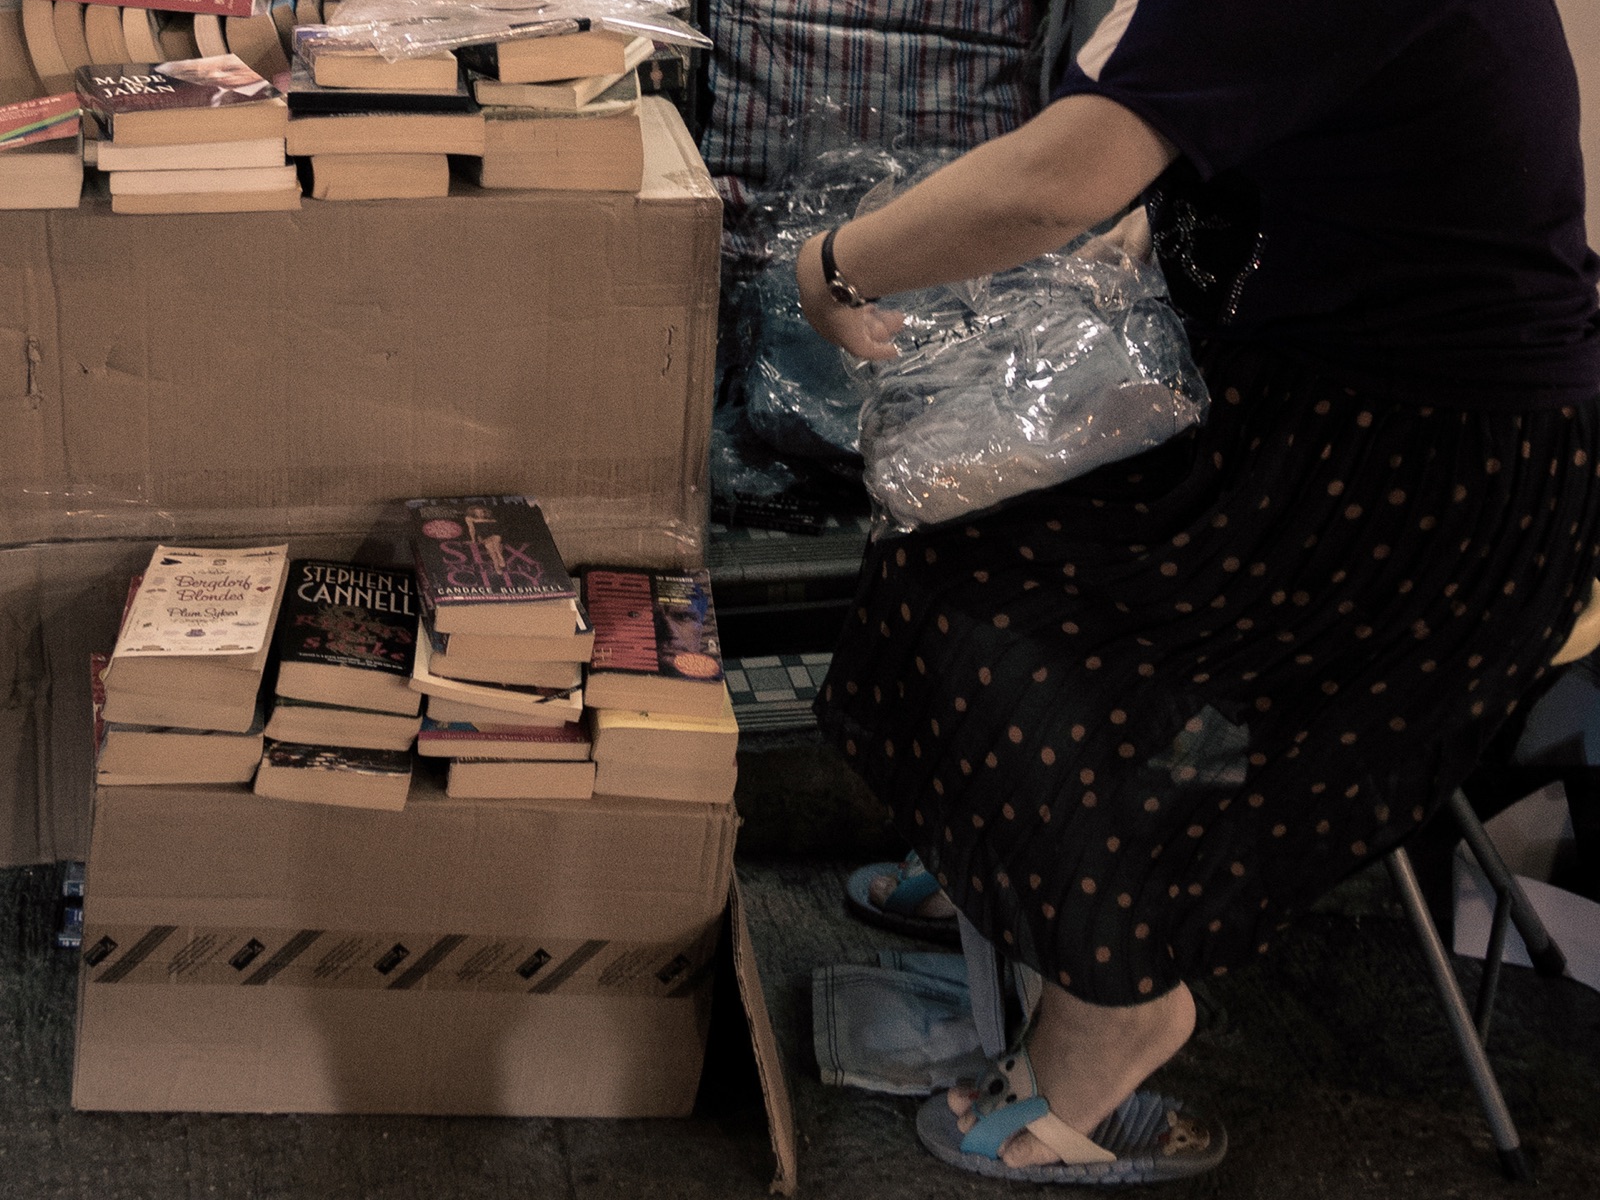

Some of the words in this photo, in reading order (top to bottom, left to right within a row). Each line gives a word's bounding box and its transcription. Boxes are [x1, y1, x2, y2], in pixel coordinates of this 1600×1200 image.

[92, 75, 167, 87] MADE
[103, 85, 176, 99] JAPAN
[174, 575, 253, 592] Bergdorf
[303, 565, 393, 592] STEPHEN
[397, 577, 414, 596] J.
[176, 588, 245, 602] Blondes
[437, 585, 493, 596] CANDACE
[500, 584, 565, 595] BUSHNELL
[297, 581, 416, 617] CANNELL
[167, 607, 203, 618] Plum
[204, 607, 239, 620] Sykes
